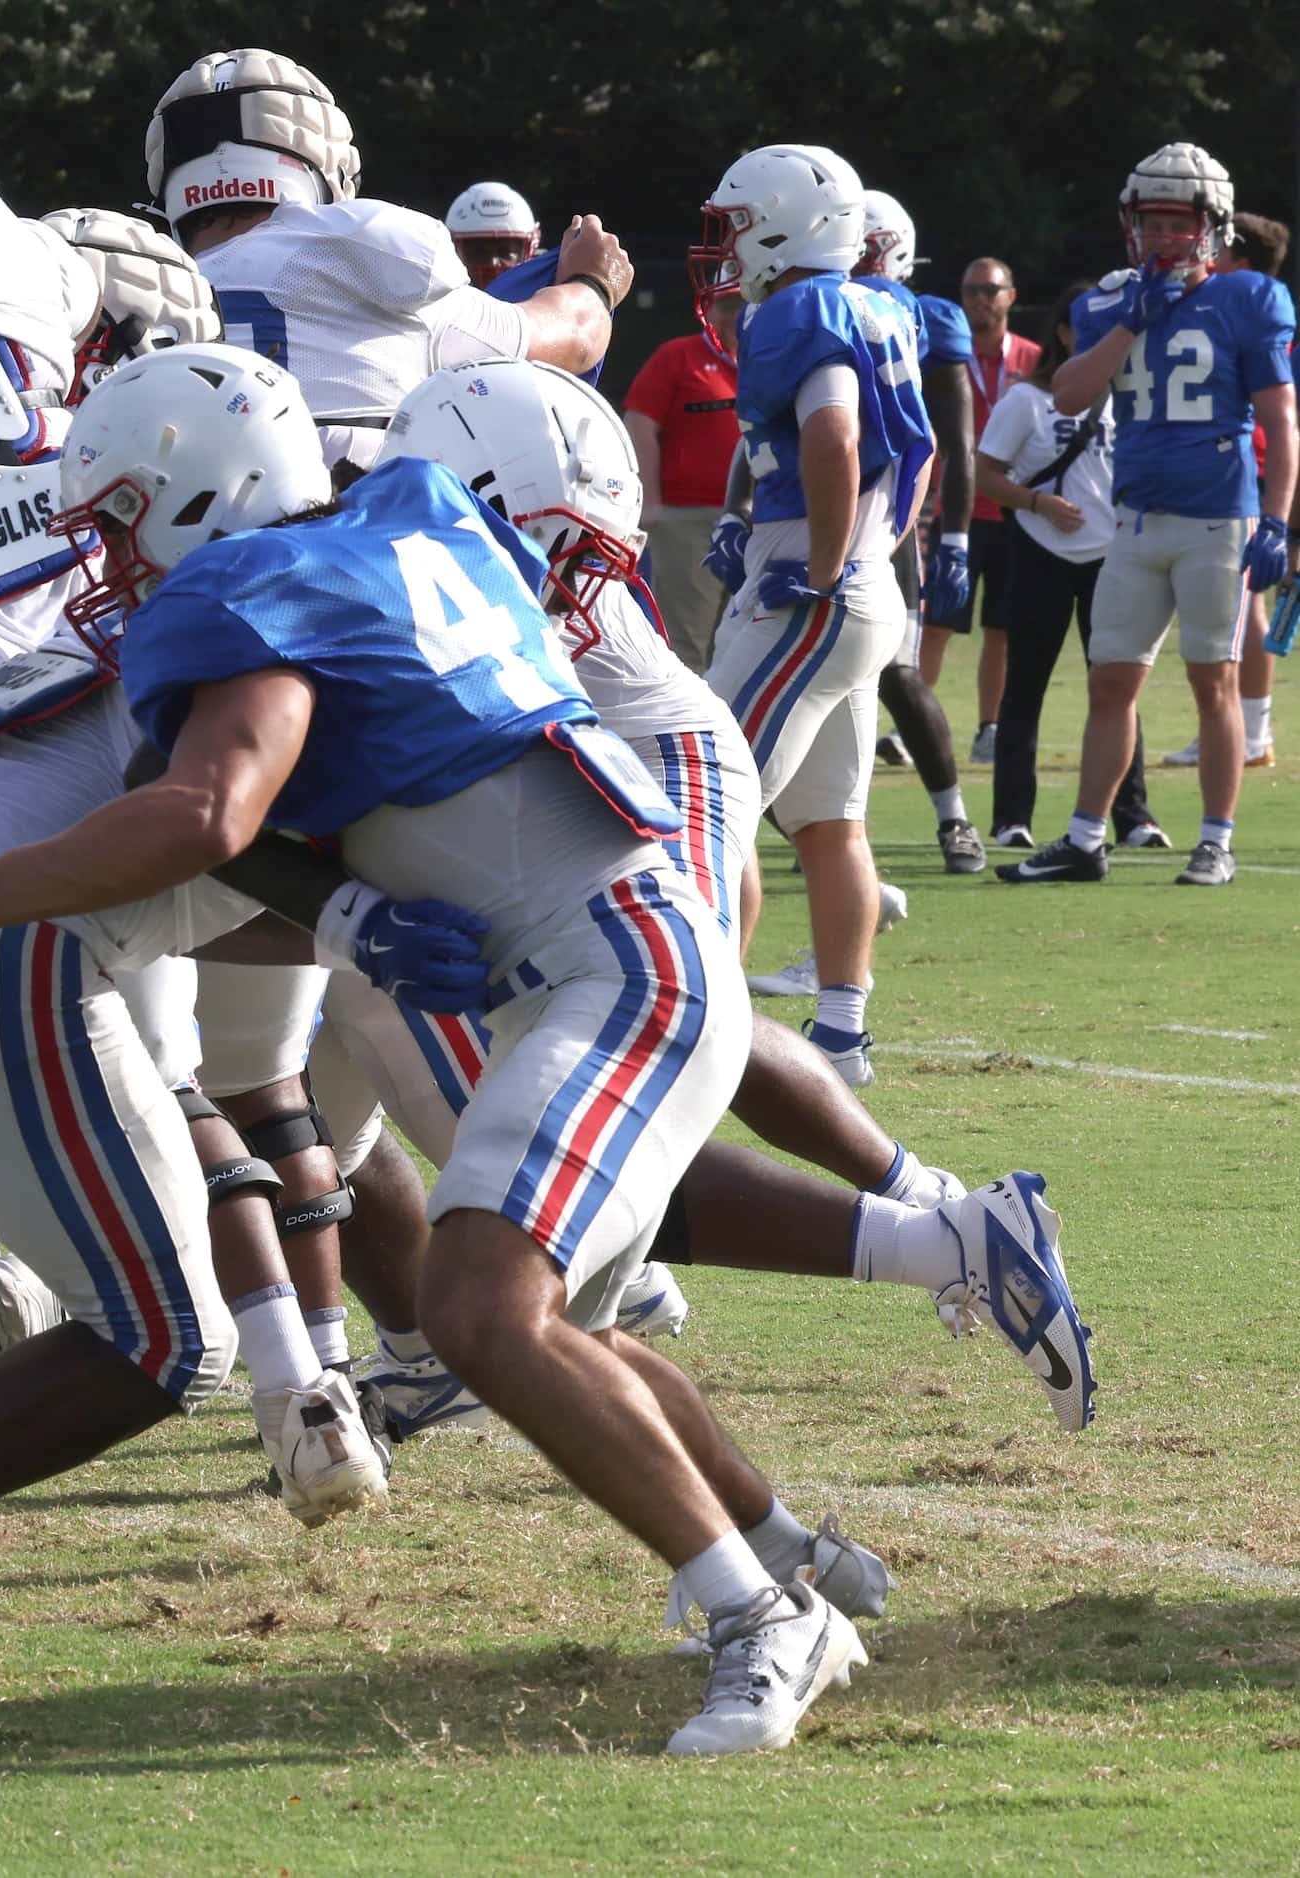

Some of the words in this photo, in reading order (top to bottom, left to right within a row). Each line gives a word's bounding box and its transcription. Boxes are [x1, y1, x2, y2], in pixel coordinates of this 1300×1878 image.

[184, 178, 276, 207] Riddell
[473, 378, 489, 397] SMU
[1114, 329, 1214, 421] 42
[226, 392, 249, 415] SMU
[606, 478, 625, 492] SMU
[205, 1162, 254, 1188] ONJOY
[286, 1201, 341, 1227] DONJOY
